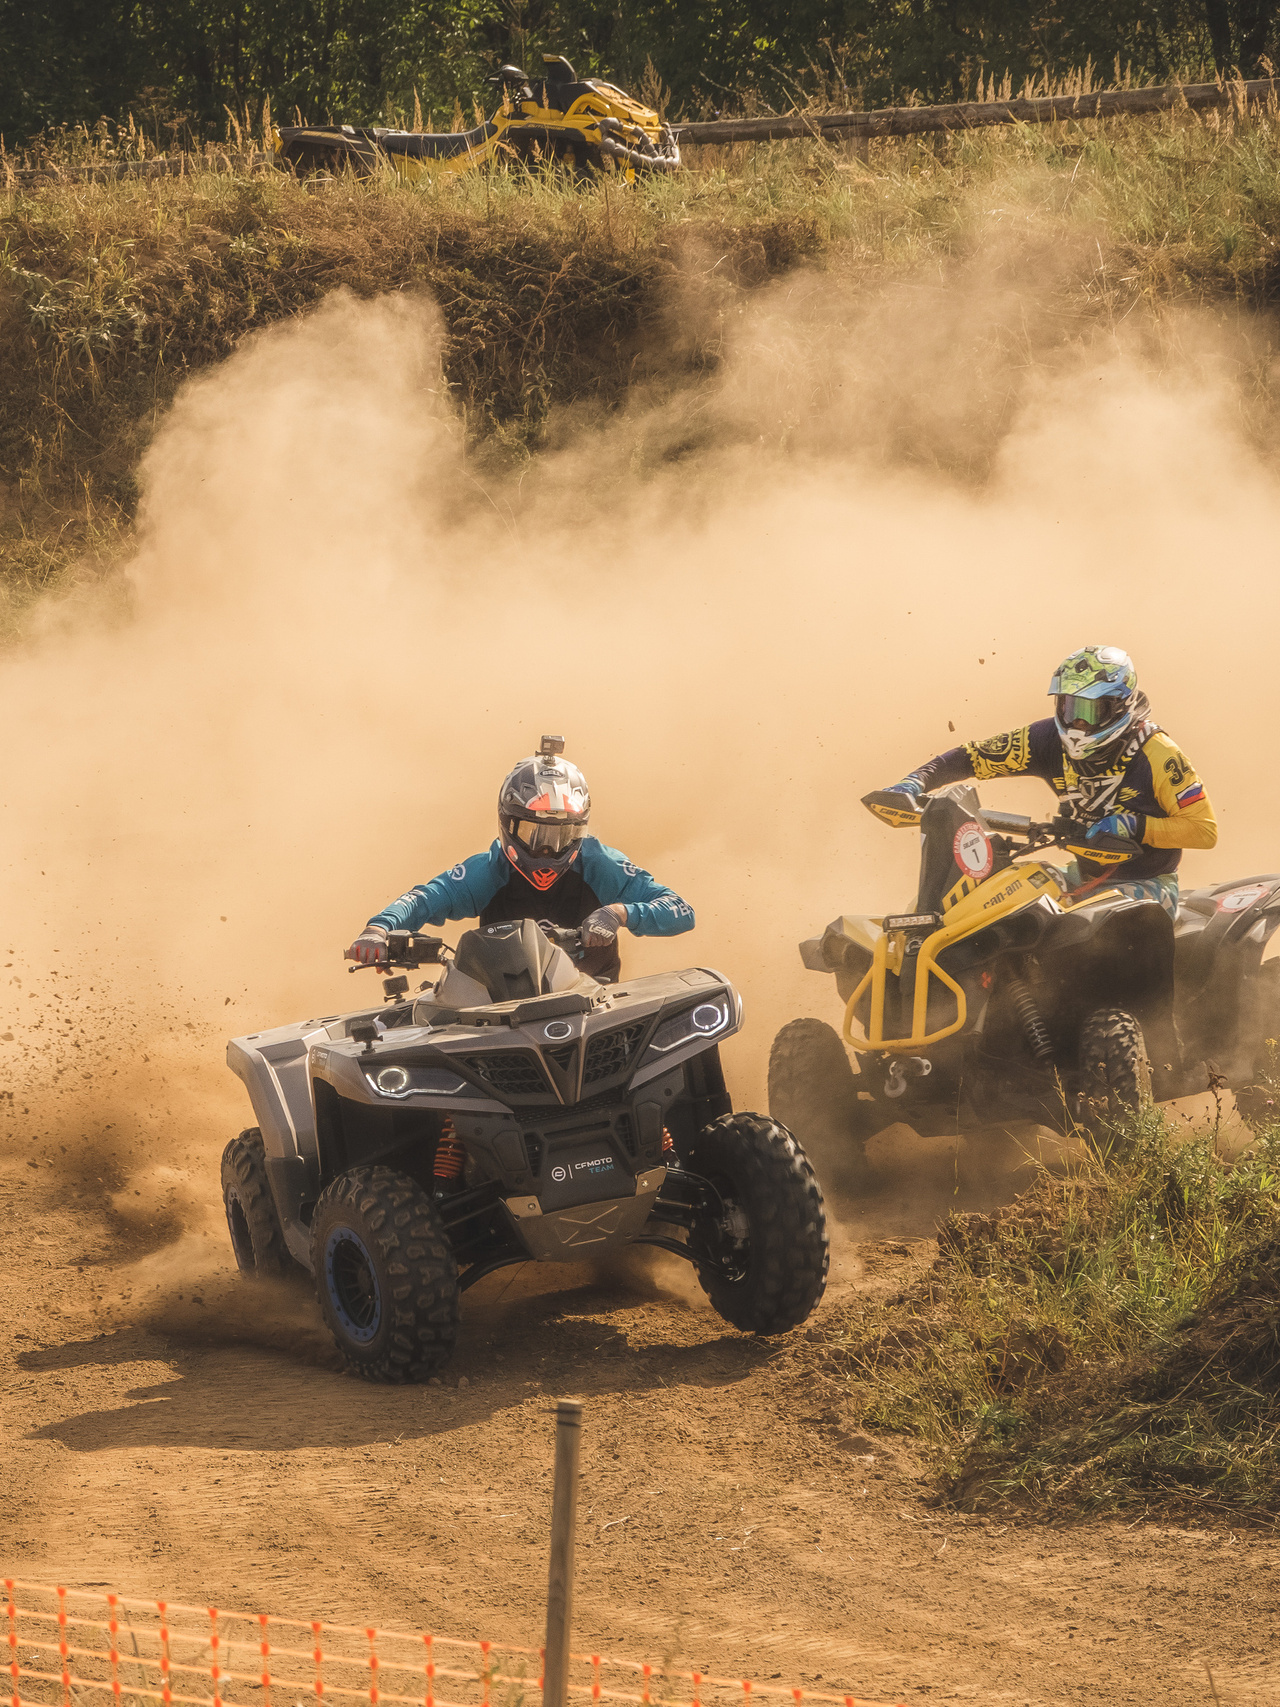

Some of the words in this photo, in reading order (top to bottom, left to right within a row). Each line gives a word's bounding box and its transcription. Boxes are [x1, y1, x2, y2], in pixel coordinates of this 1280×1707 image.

[878, 807, 918, 821] can-am
[972, 849, 980, 863] 1
[1083, 850, 1121, 860] can-am
[983, 879, 1023, 910] can-am
[574, 1156, 613, 1170] CFMOTO
[588, 1164, 615, 1174] TEAM
